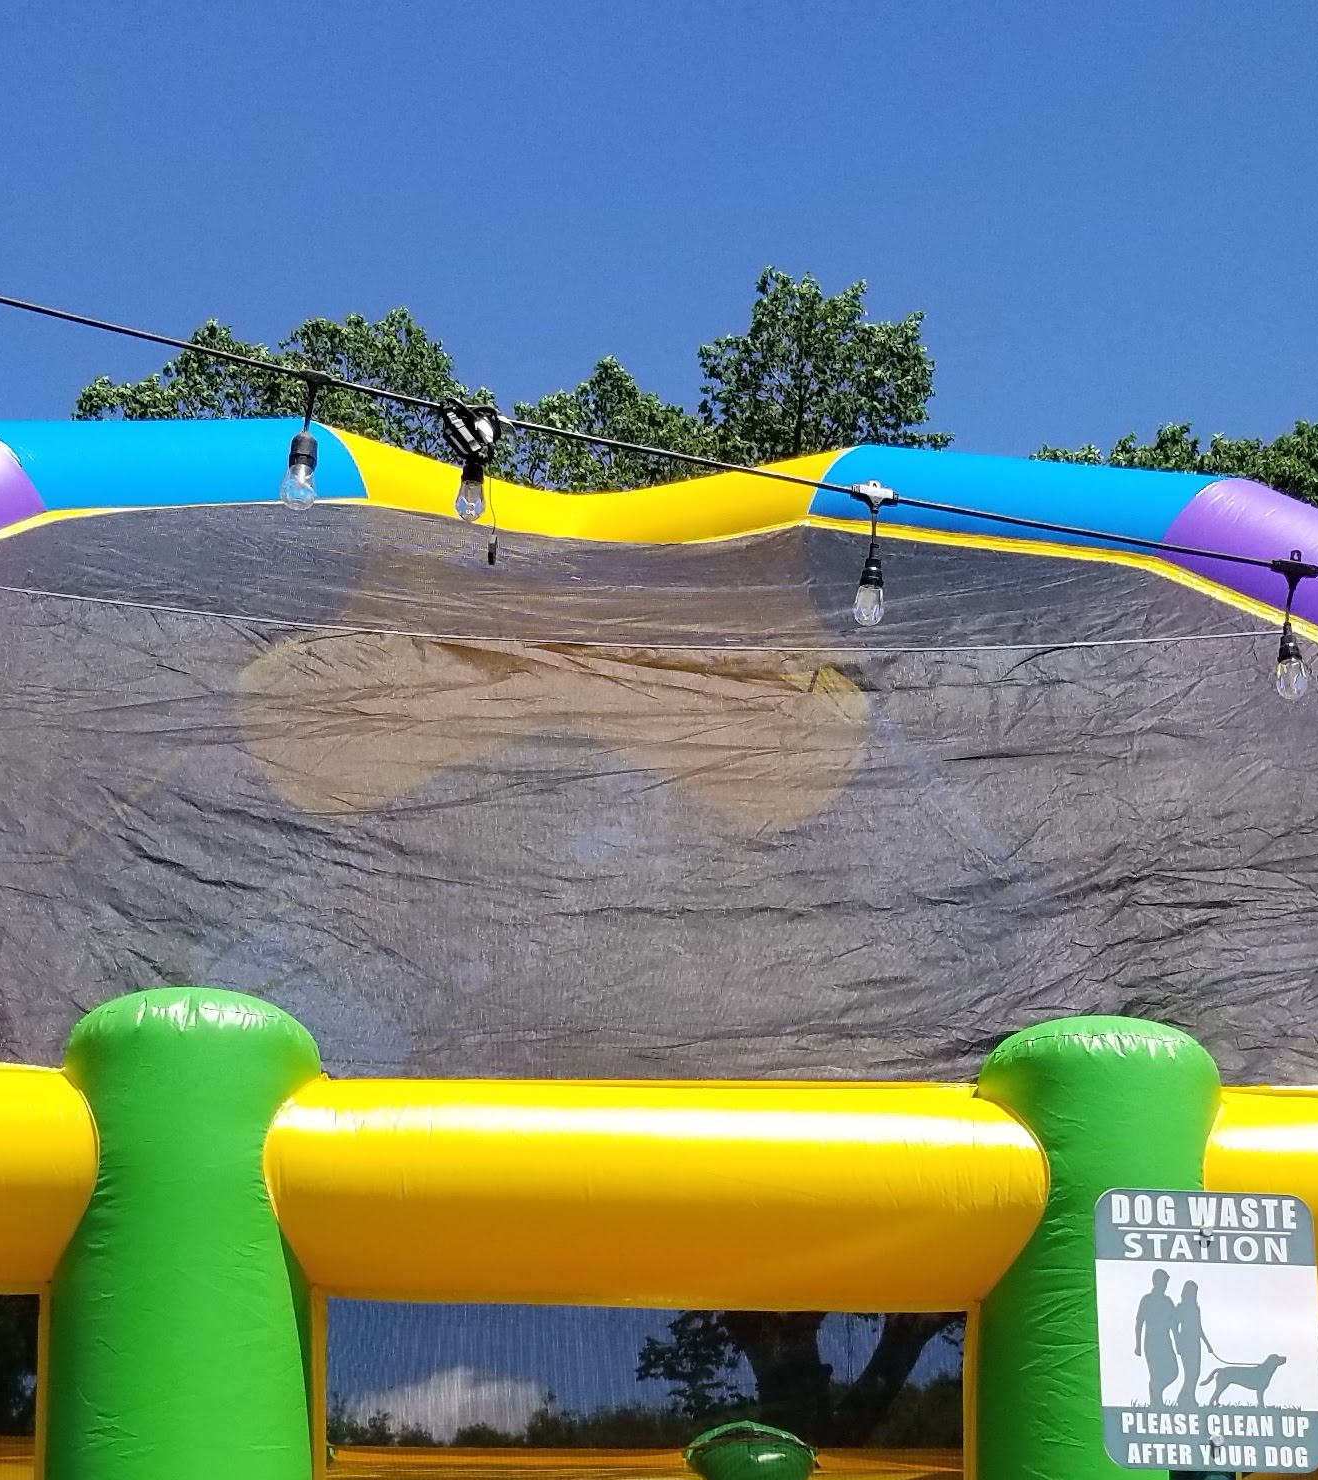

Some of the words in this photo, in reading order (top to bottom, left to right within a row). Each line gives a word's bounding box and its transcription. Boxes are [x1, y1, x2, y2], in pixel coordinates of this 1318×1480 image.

[1111, 1194, 1176, 1226] DOG
[1188, 1196, 1297, 1230] WASTE
[1123, 1232, 1289, 1263] STATION
[1121, 1412, 1200, 1435] PLEASE
[1207, 1414, 1274, 1437] CLEAN
[1281, 1416, 1310, 1437] UP
[1127, 1442, 1192, 1465] AFTER
[1199, 1444, 1257, 1467] YOUR
[1265, 1446, 1309, 1468] DOG
